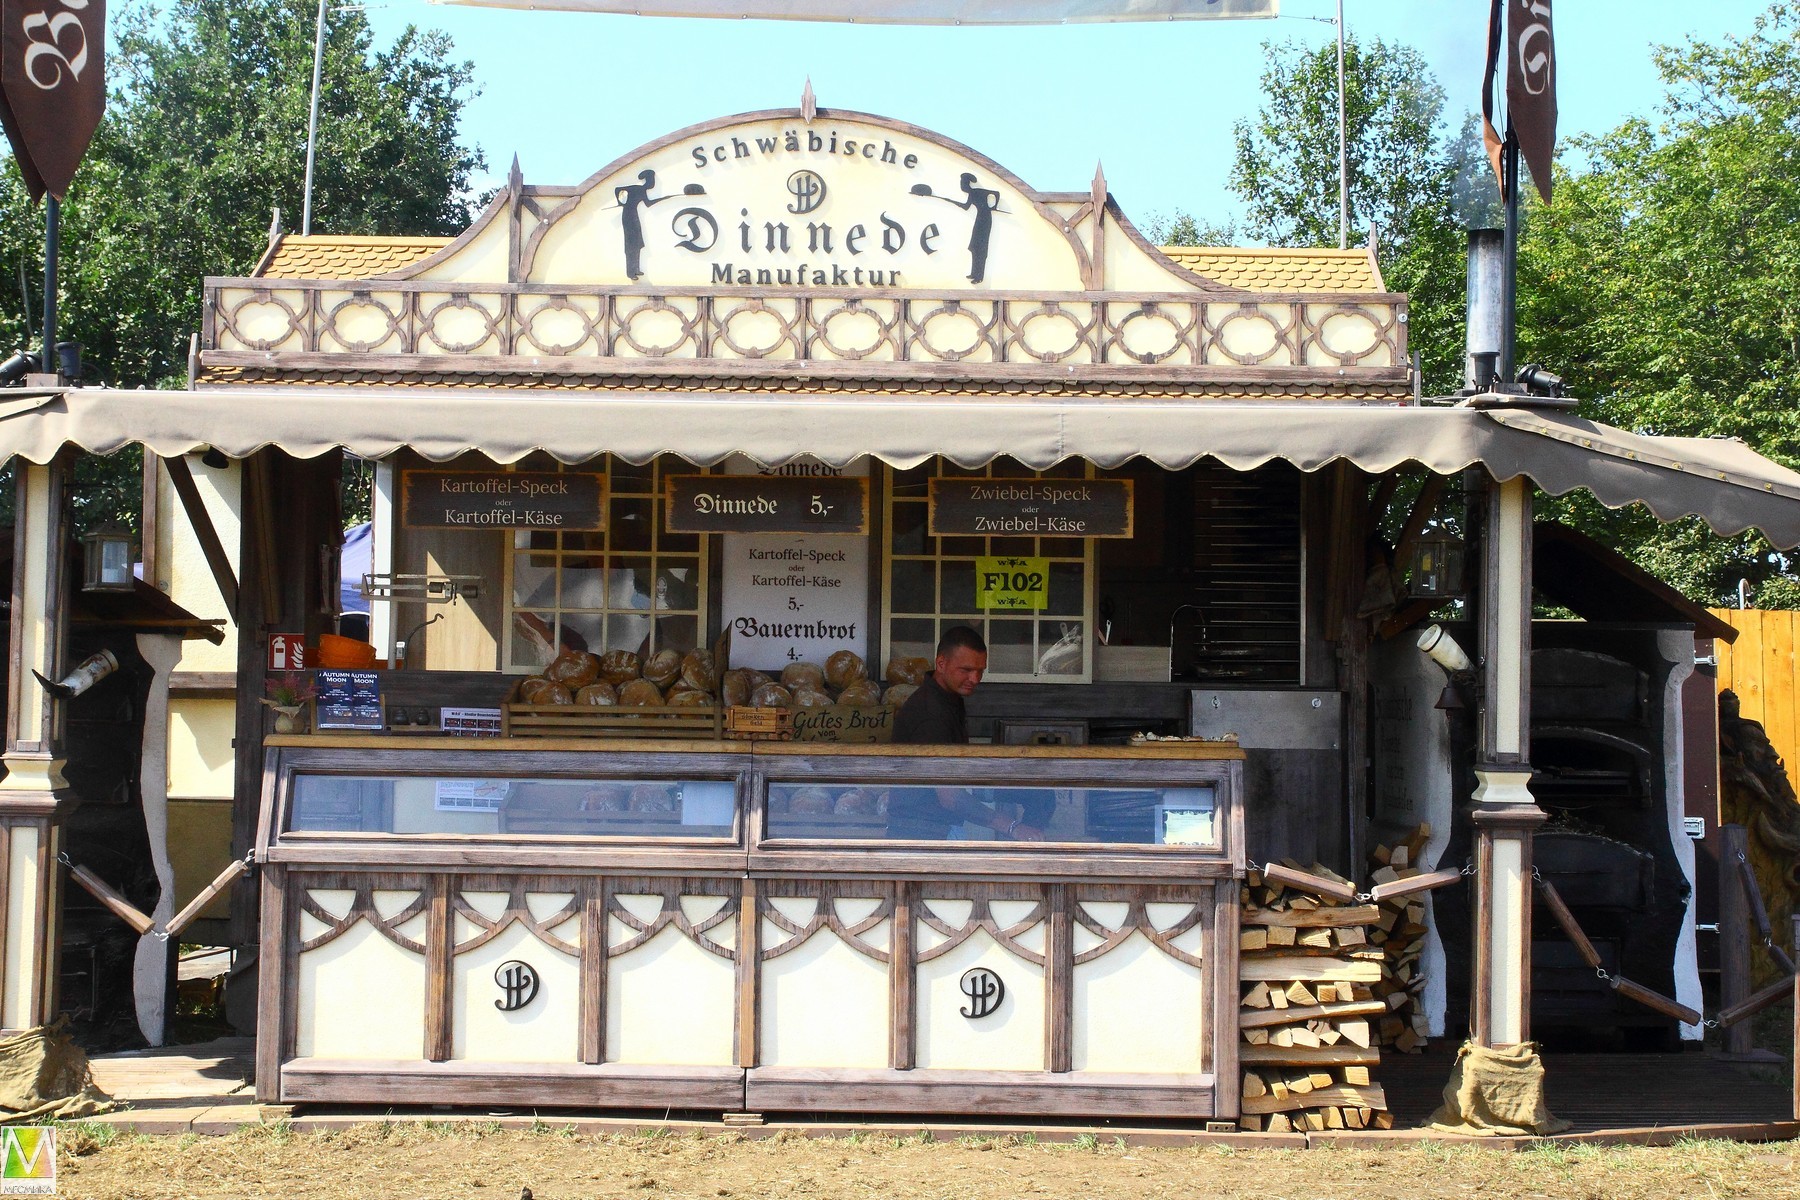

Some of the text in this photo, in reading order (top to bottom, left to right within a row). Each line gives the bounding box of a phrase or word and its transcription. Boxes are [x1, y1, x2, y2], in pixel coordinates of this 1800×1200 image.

[692, 129, 919, 170] Schwäbische
[671, 206, 941, 256] Dinnede
[710, 262, 902, 287] Manufaktur
[440, 478, 568, 499] Kartoffel-Speck
[970, 485, 1092, 505] Zwiebel-Speck
[494, 499, 513, 507] oder
[693, 492, 835, 517] Dinnede 5,-
[1021, 506, 1040, 514] oder
[444, 508, 563, 526] Kartoffel-Käse
[974, 516, 1086, 532] Zwiebel-Käse
[748, 548, 846, 565] Kartoffel-Speck
[788, 564, 805, 572] oder
[751, 574, 842, 588] Kartoffel-Käse
[982, 571, 1043, 592] F102
[788, 596, 804, 612] 5,-
[734, 617, 856, 641] Bauernbrot
[786, 646, 803, 662] 4,-
[793, 709, 893, 739] Gutes Brot
